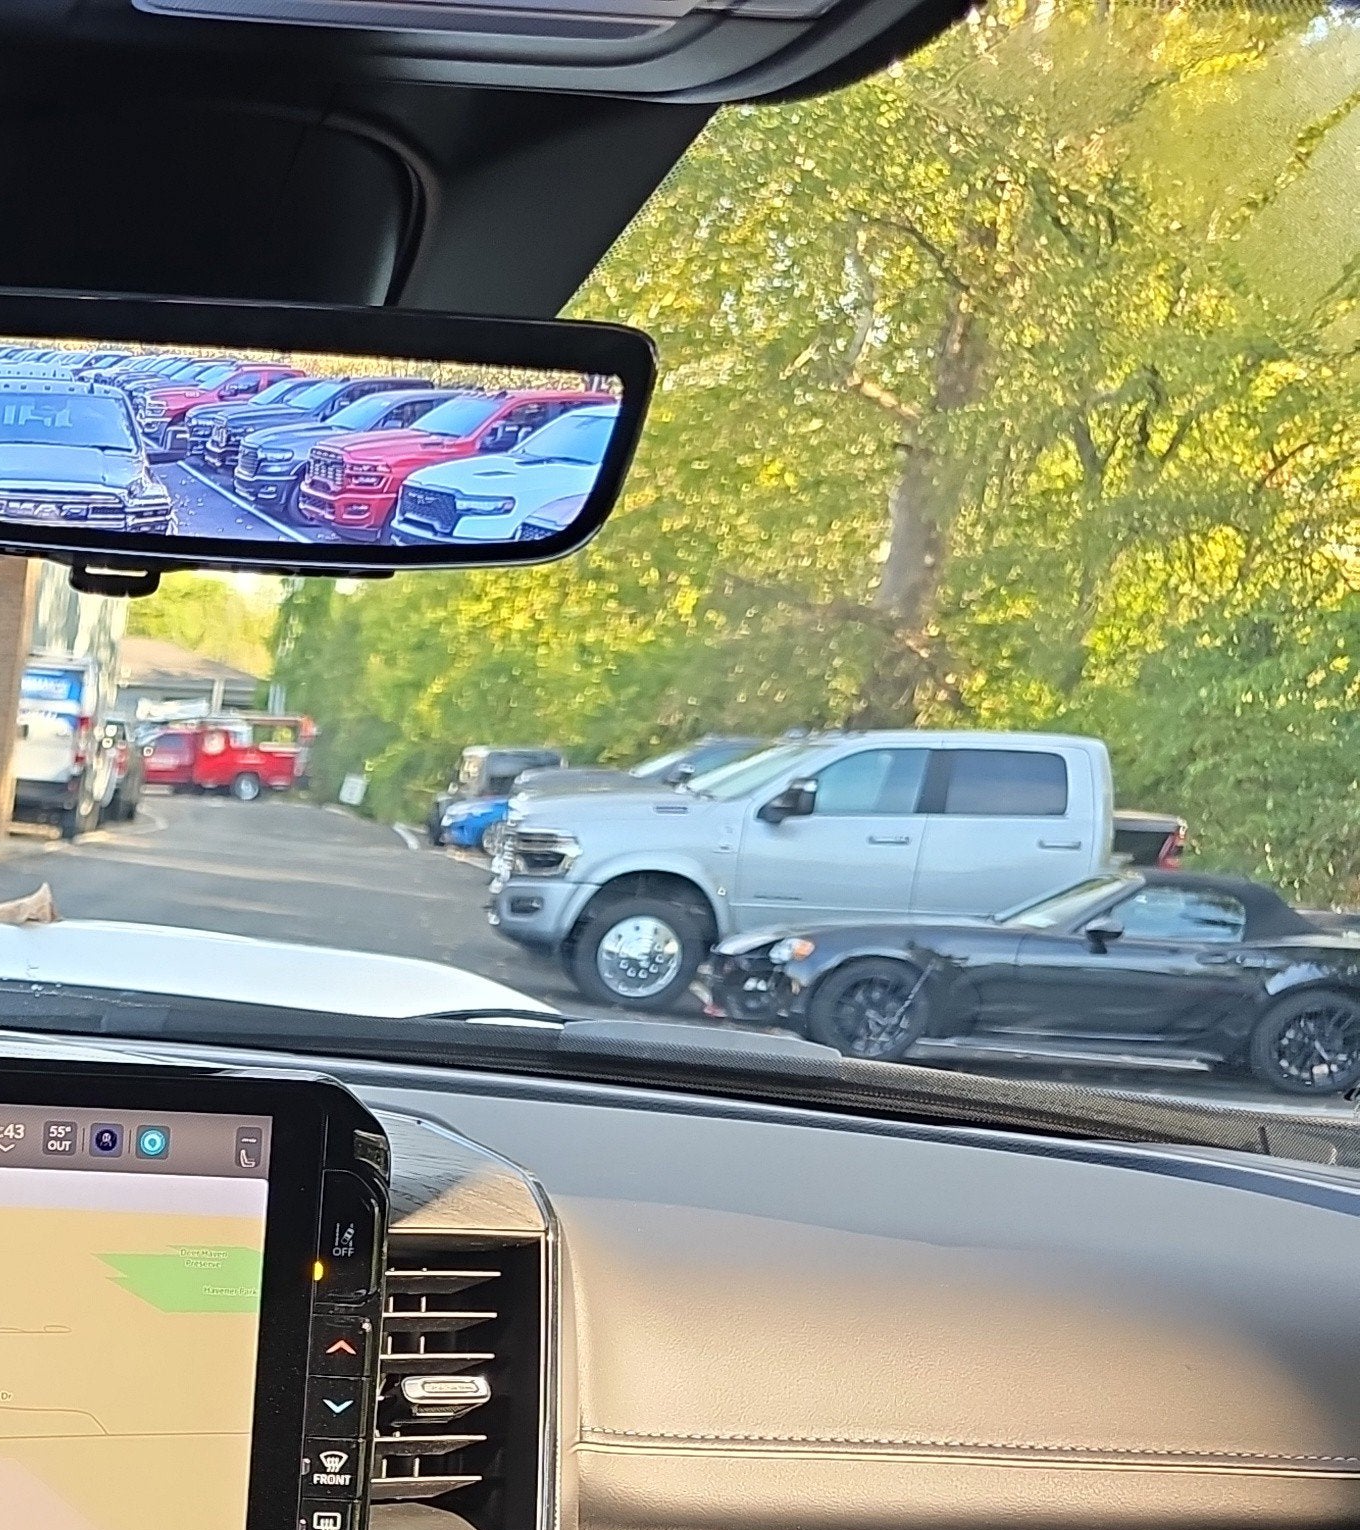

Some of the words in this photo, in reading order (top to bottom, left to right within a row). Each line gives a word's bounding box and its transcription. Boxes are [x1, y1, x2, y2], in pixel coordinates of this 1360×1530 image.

[48, 1125, 72, 1138] 55°
[47, 1139, 72, 1152] OUT
[332, 1246, 356, 1258] OFF
[0, 1391, 13, 1401] Dr
[312, 1473, 352, 1487] FRONT
